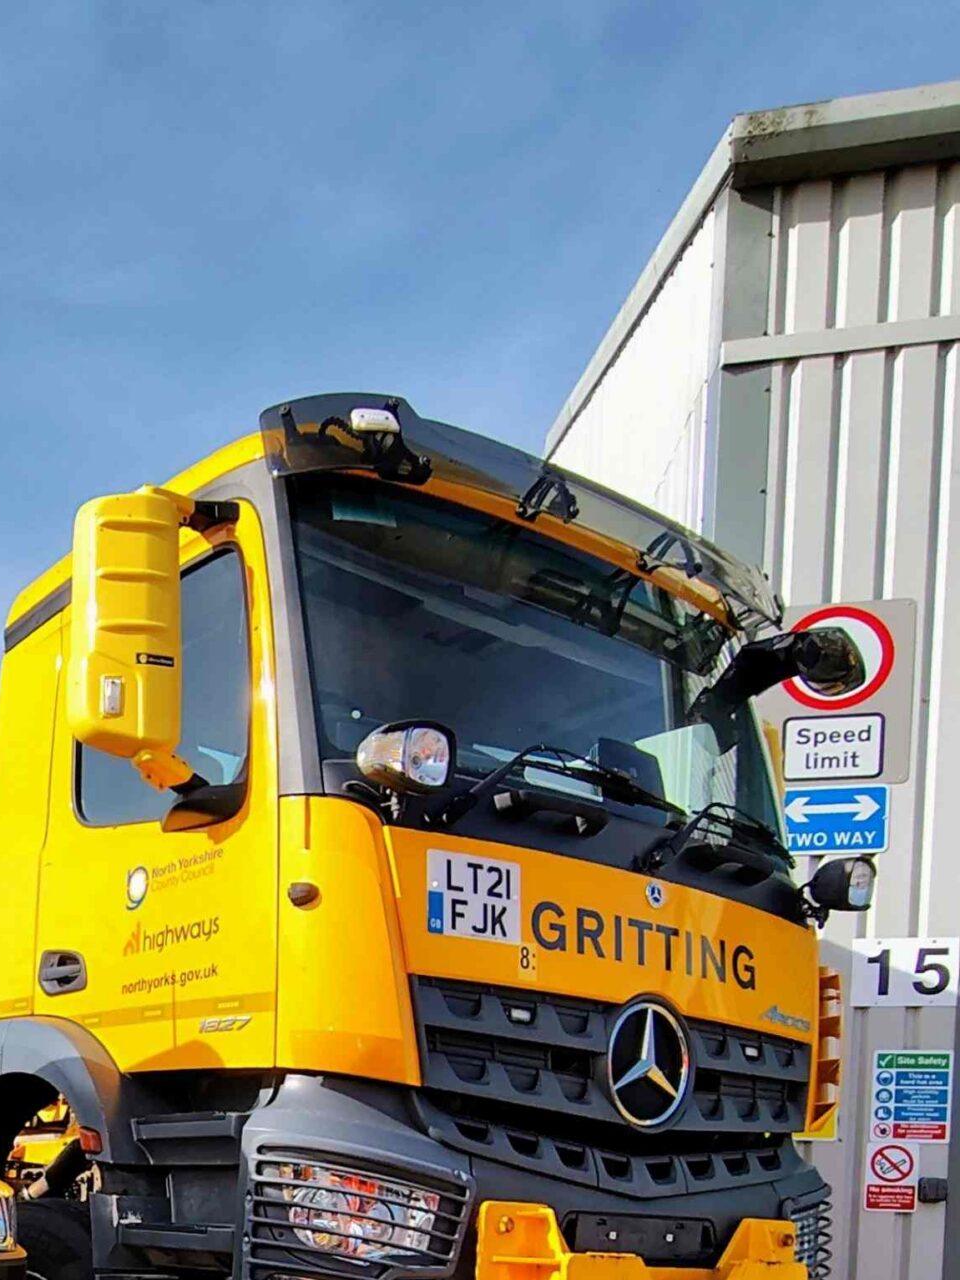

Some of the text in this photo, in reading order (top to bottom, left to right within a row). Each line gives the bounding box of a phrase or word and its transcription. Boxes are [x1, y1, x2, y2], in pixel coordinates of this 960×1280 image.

[796, 725, 872, 747] Speed
[805, 751, 860, 770] limit
[787, 831, 877, 848] TWO WAY
[151, 862, 215, 892] County Council
[152, 848, 224, 879] North Yorkshire
[446, 858, 511, 900] LT21
[451, 898, 507, 938] FJK
[142, 916, 220, 953] highways
[531, 900, 756, 991] GRITTING
[122, 962, 219, 995] northyorks.gov.uk
[199, 1014, 253, 1034] 1827
[897, 1055, 947, 1067] Site Safety
